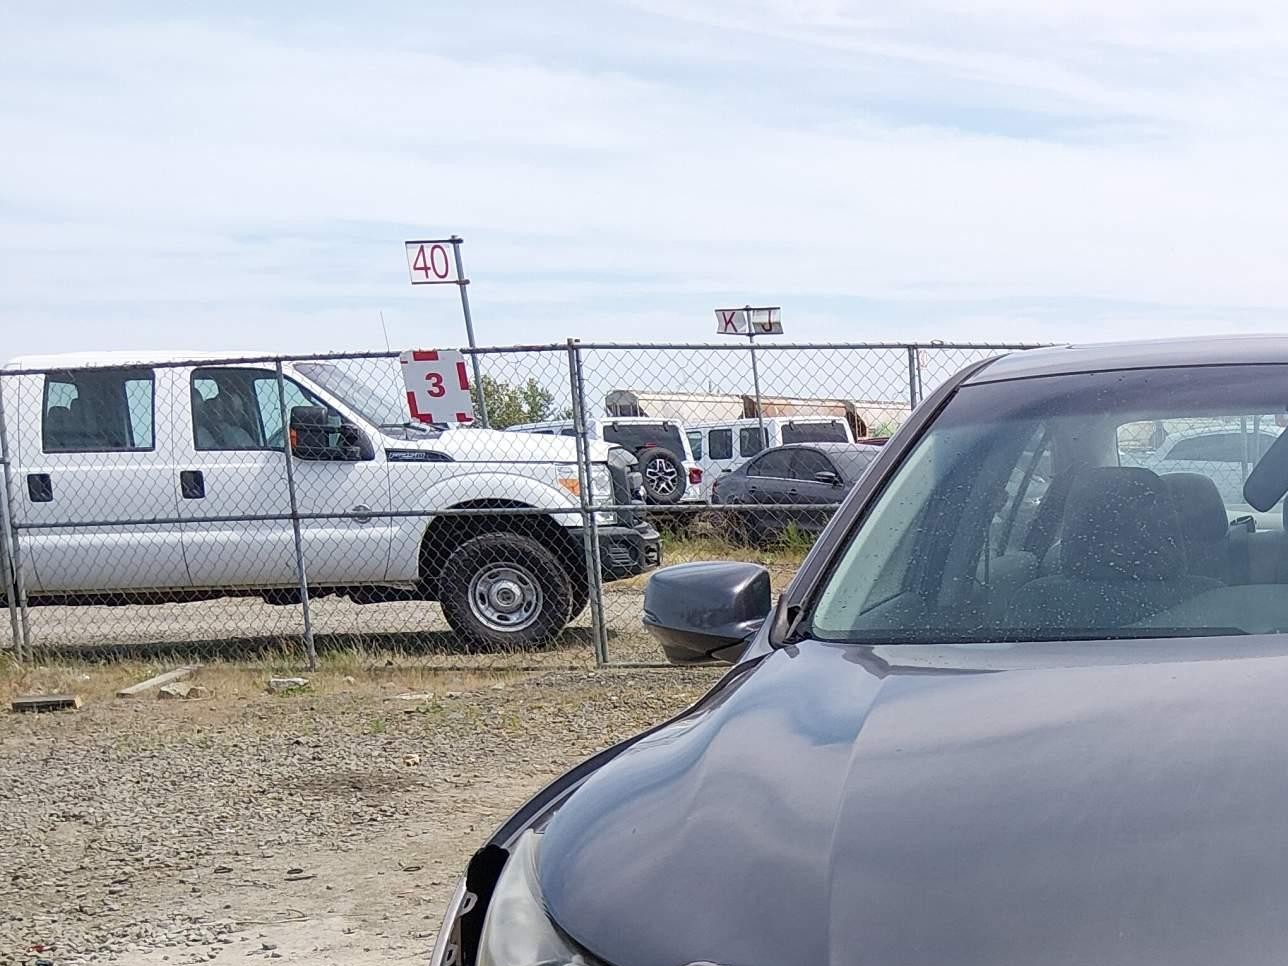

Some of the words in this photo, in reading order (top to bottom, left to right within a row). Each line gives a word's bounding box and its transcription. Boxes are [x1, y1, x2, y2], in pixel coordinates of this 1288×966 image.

[412, 244, 450, 279] 40
[721, 311, 738, 332] K
[761, 310, 773, 332] J
[425, 373, 445, 398] 3
